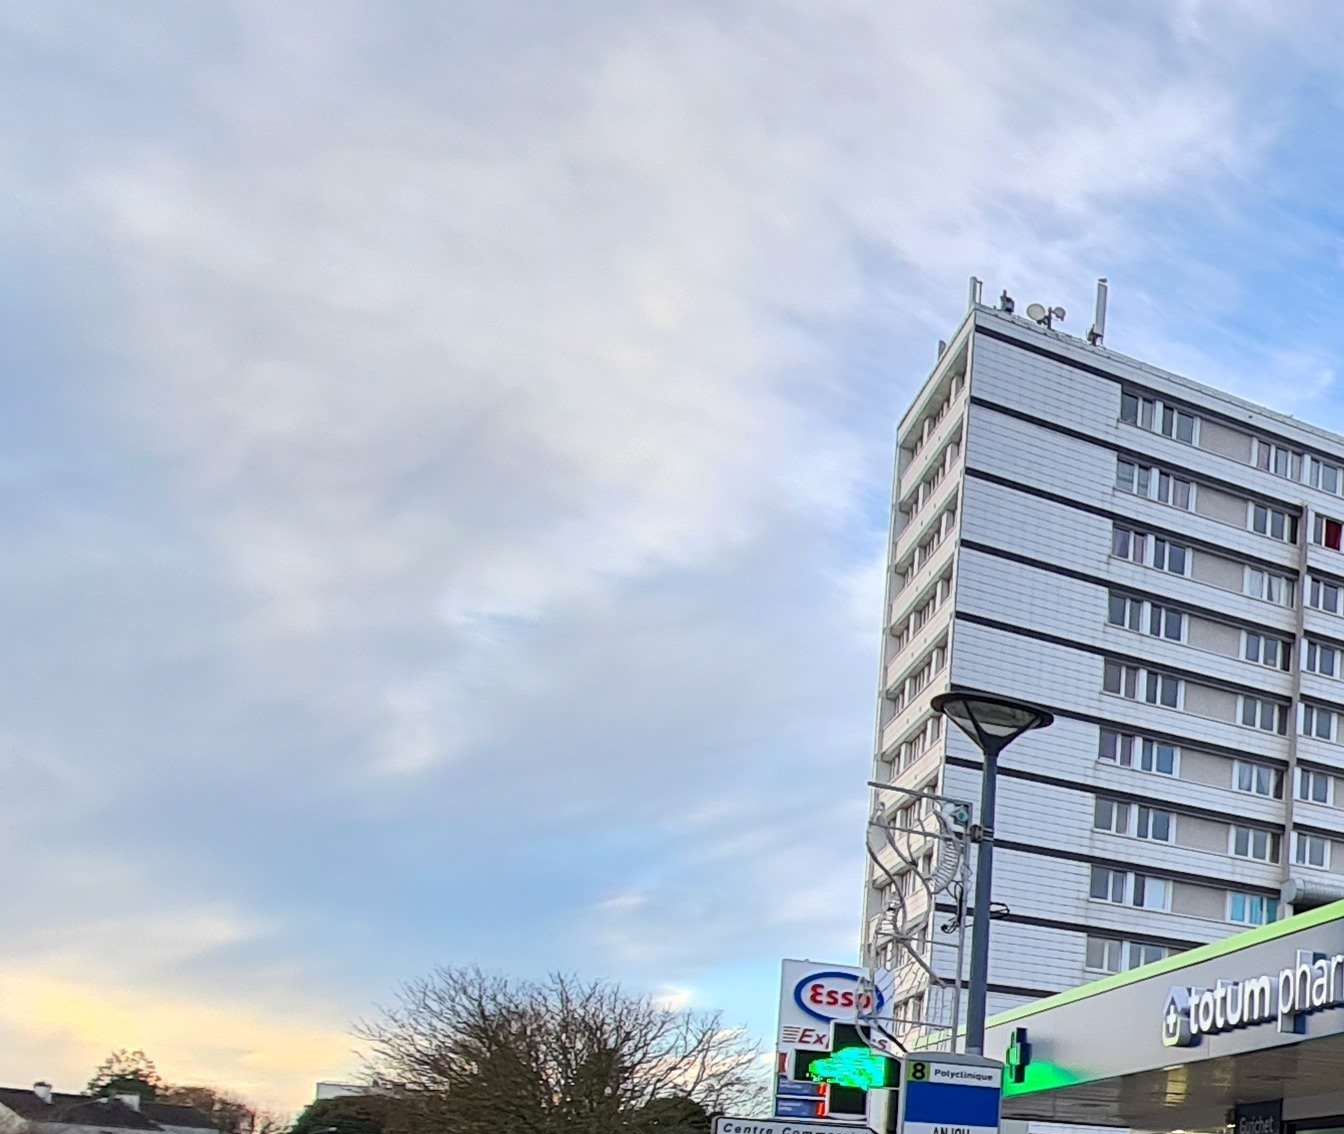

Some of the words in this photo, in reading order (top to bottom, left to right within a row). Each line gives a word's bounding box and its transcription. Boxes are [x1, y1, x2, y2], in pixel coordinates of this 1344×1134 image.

[809, 983, 873, 1009] Esso
[1188, 974, 1271, 1035] totum
[911, 1062, 926, 1080] 8
[934, 1068, 993, 1082] Polyclinique
